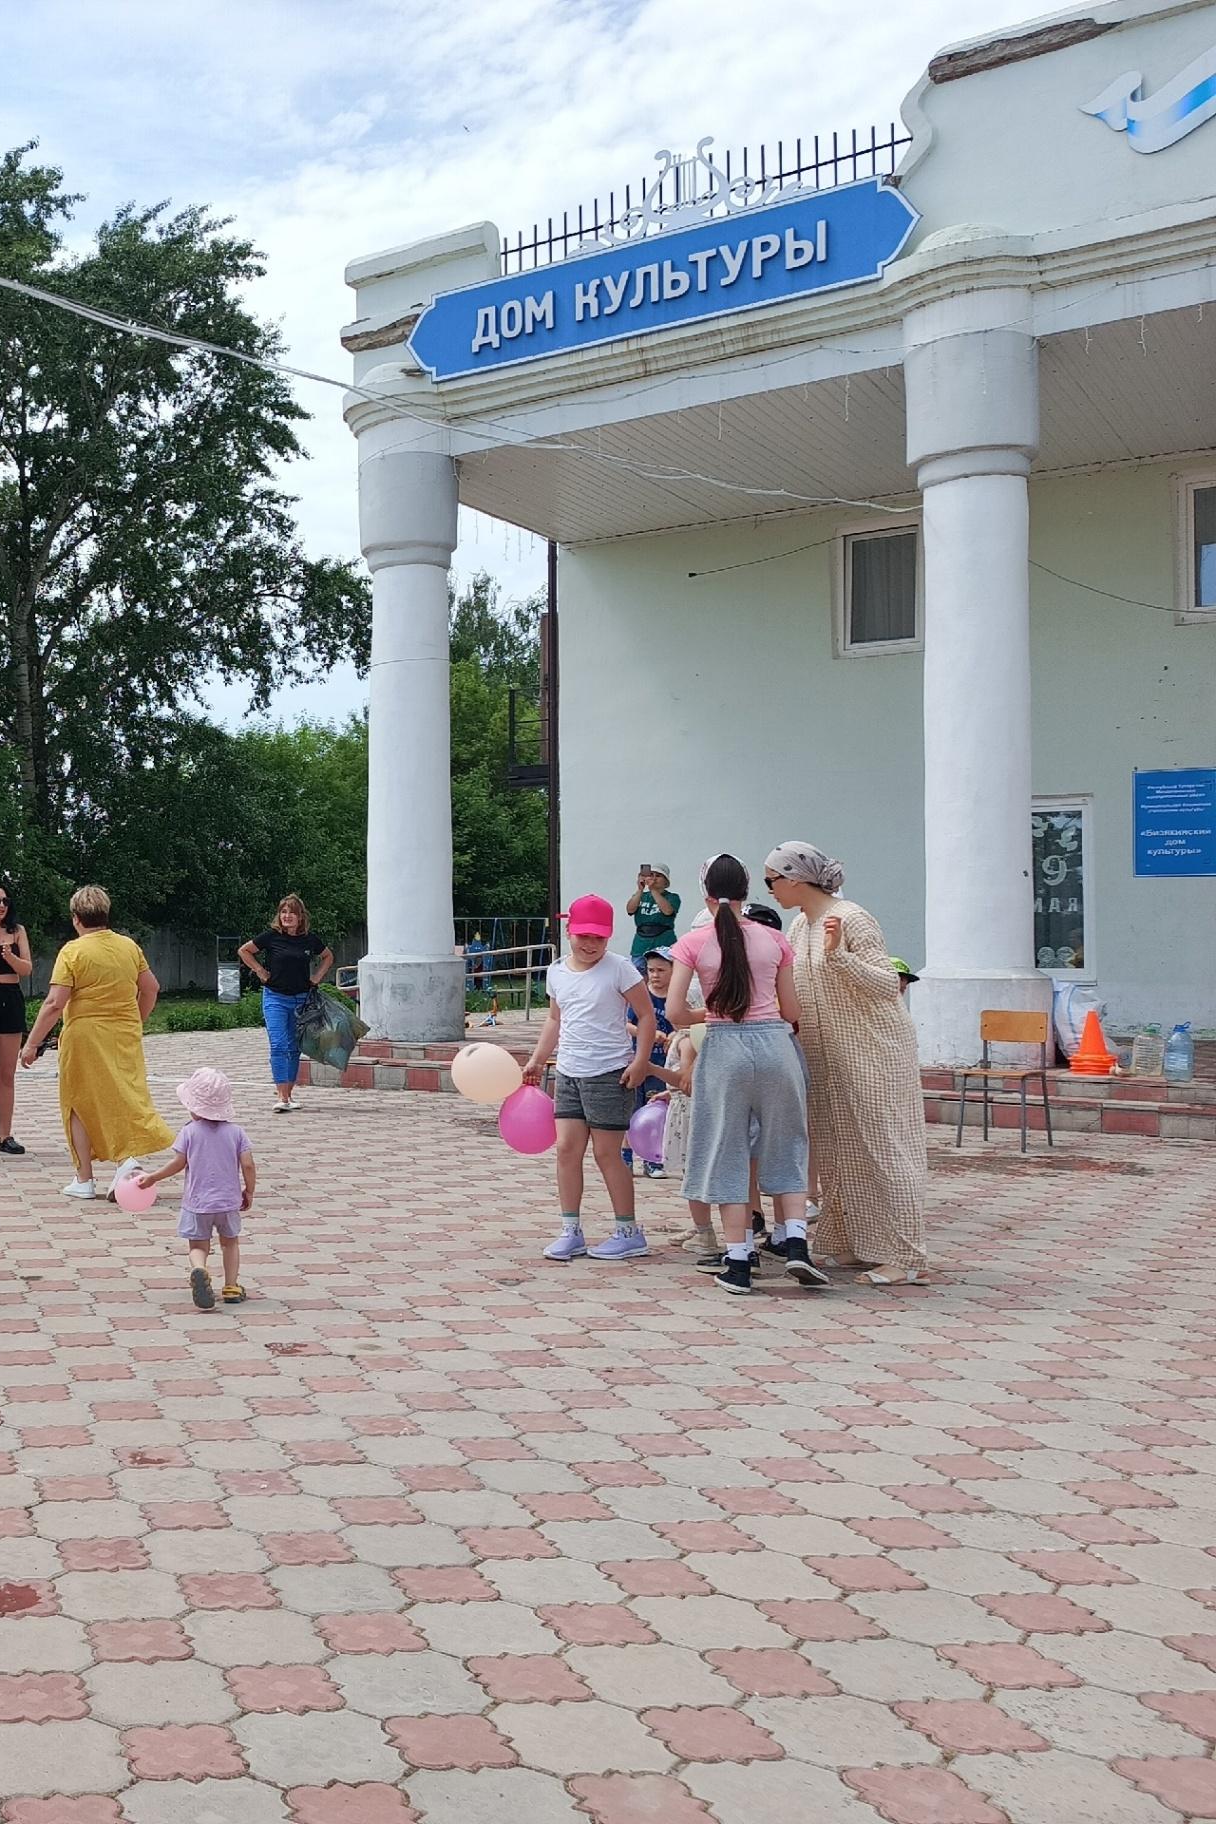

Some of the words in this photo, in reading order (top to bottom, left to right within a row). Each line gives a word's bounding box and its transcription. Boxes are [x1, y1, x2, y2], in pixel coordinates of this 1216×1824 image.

[471, 289, 554, 353] ДОМ
[574, 219, 827, 322] КУЛЬТУРЫ
[1041, 855, 1068, 886] 9
